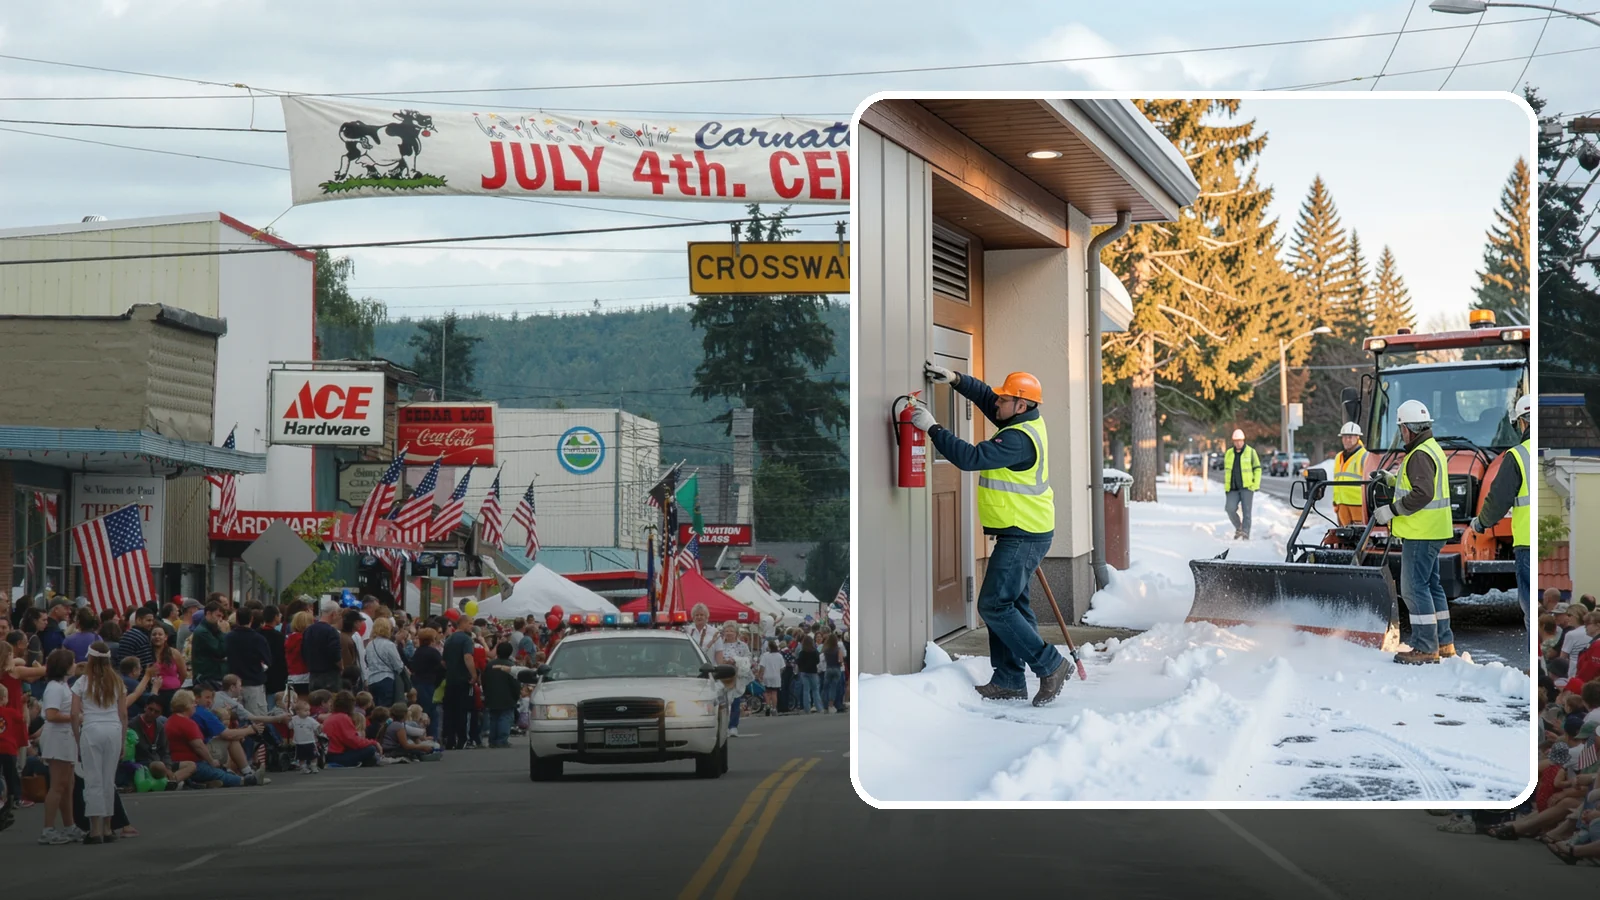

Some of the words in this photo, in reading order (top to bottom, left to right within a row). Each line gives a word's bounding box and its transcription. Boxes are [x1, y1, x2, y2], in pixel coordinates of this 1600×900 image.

[481, 141, 605, 192] JULY
[632, 149, 747, 198] 4th.
[282, 380, 374, 420] ACE
[405, 409, 453, 422] CEDAR
[283, 421, 371, 436] Hardware
[95, 484, 124, 494] Vincent
[126, 486, 136, 495] de
[137, 486, 155, 495] Paul
[688, 526, 741, 535] CRNATION
[699, 535, 730, 543] GLASS
